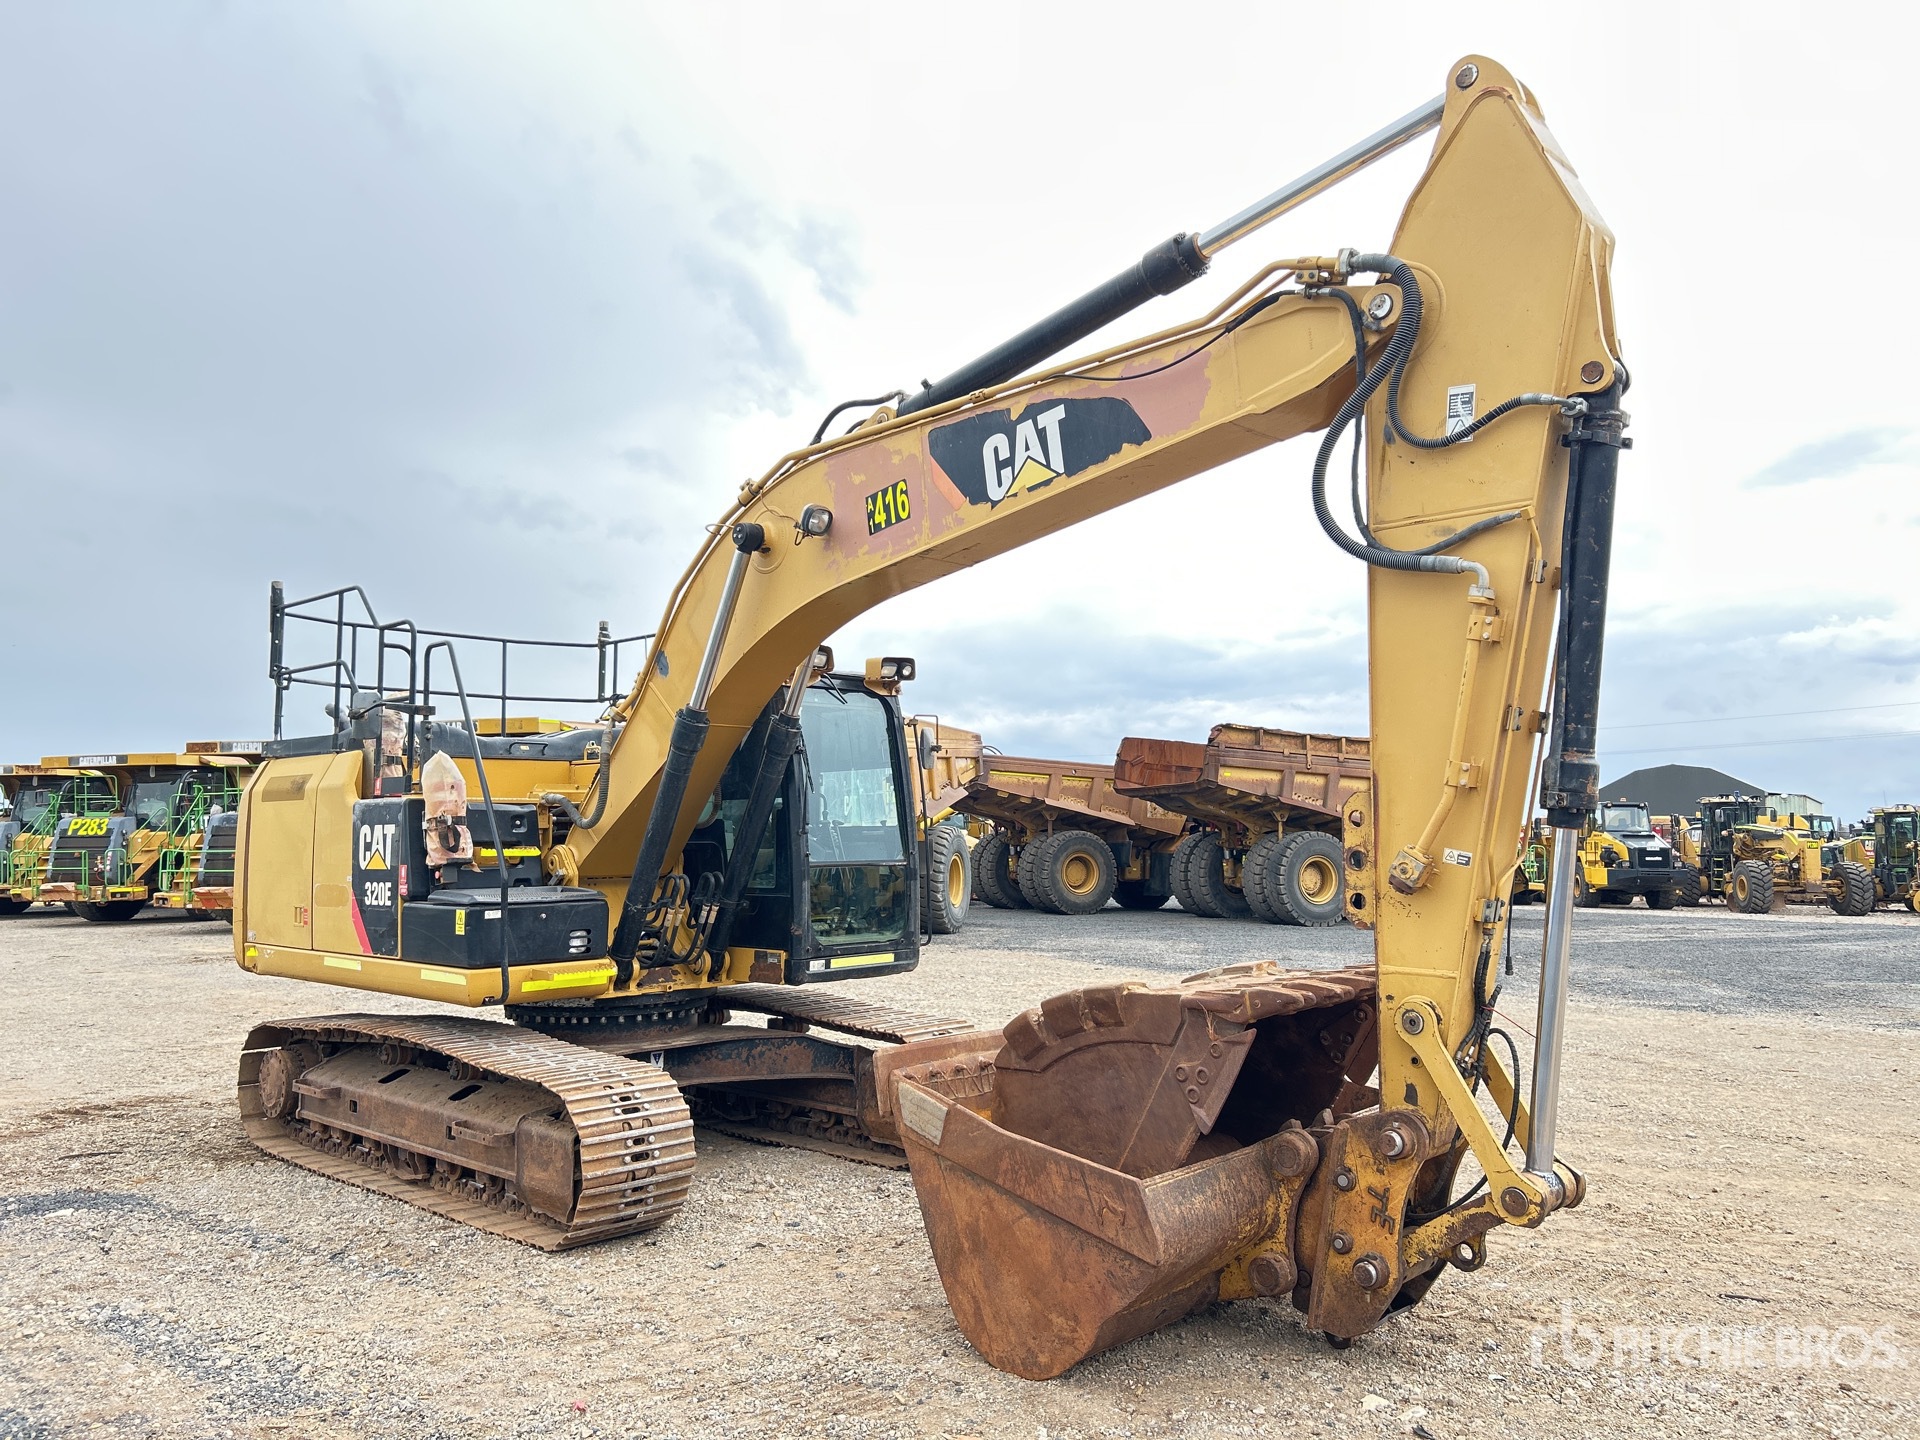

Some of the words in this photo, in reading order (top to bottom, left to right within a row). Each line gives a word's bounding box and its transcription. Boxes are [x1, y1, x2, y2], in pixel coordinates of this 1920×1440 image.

[983, 404, 1066, 501] CAT
[875, 481, 910, 528] 416
[67, 818, 110, 836] P283
[359, 824, 395, 870] CAT
[365, 881, 391, 906] 320E
